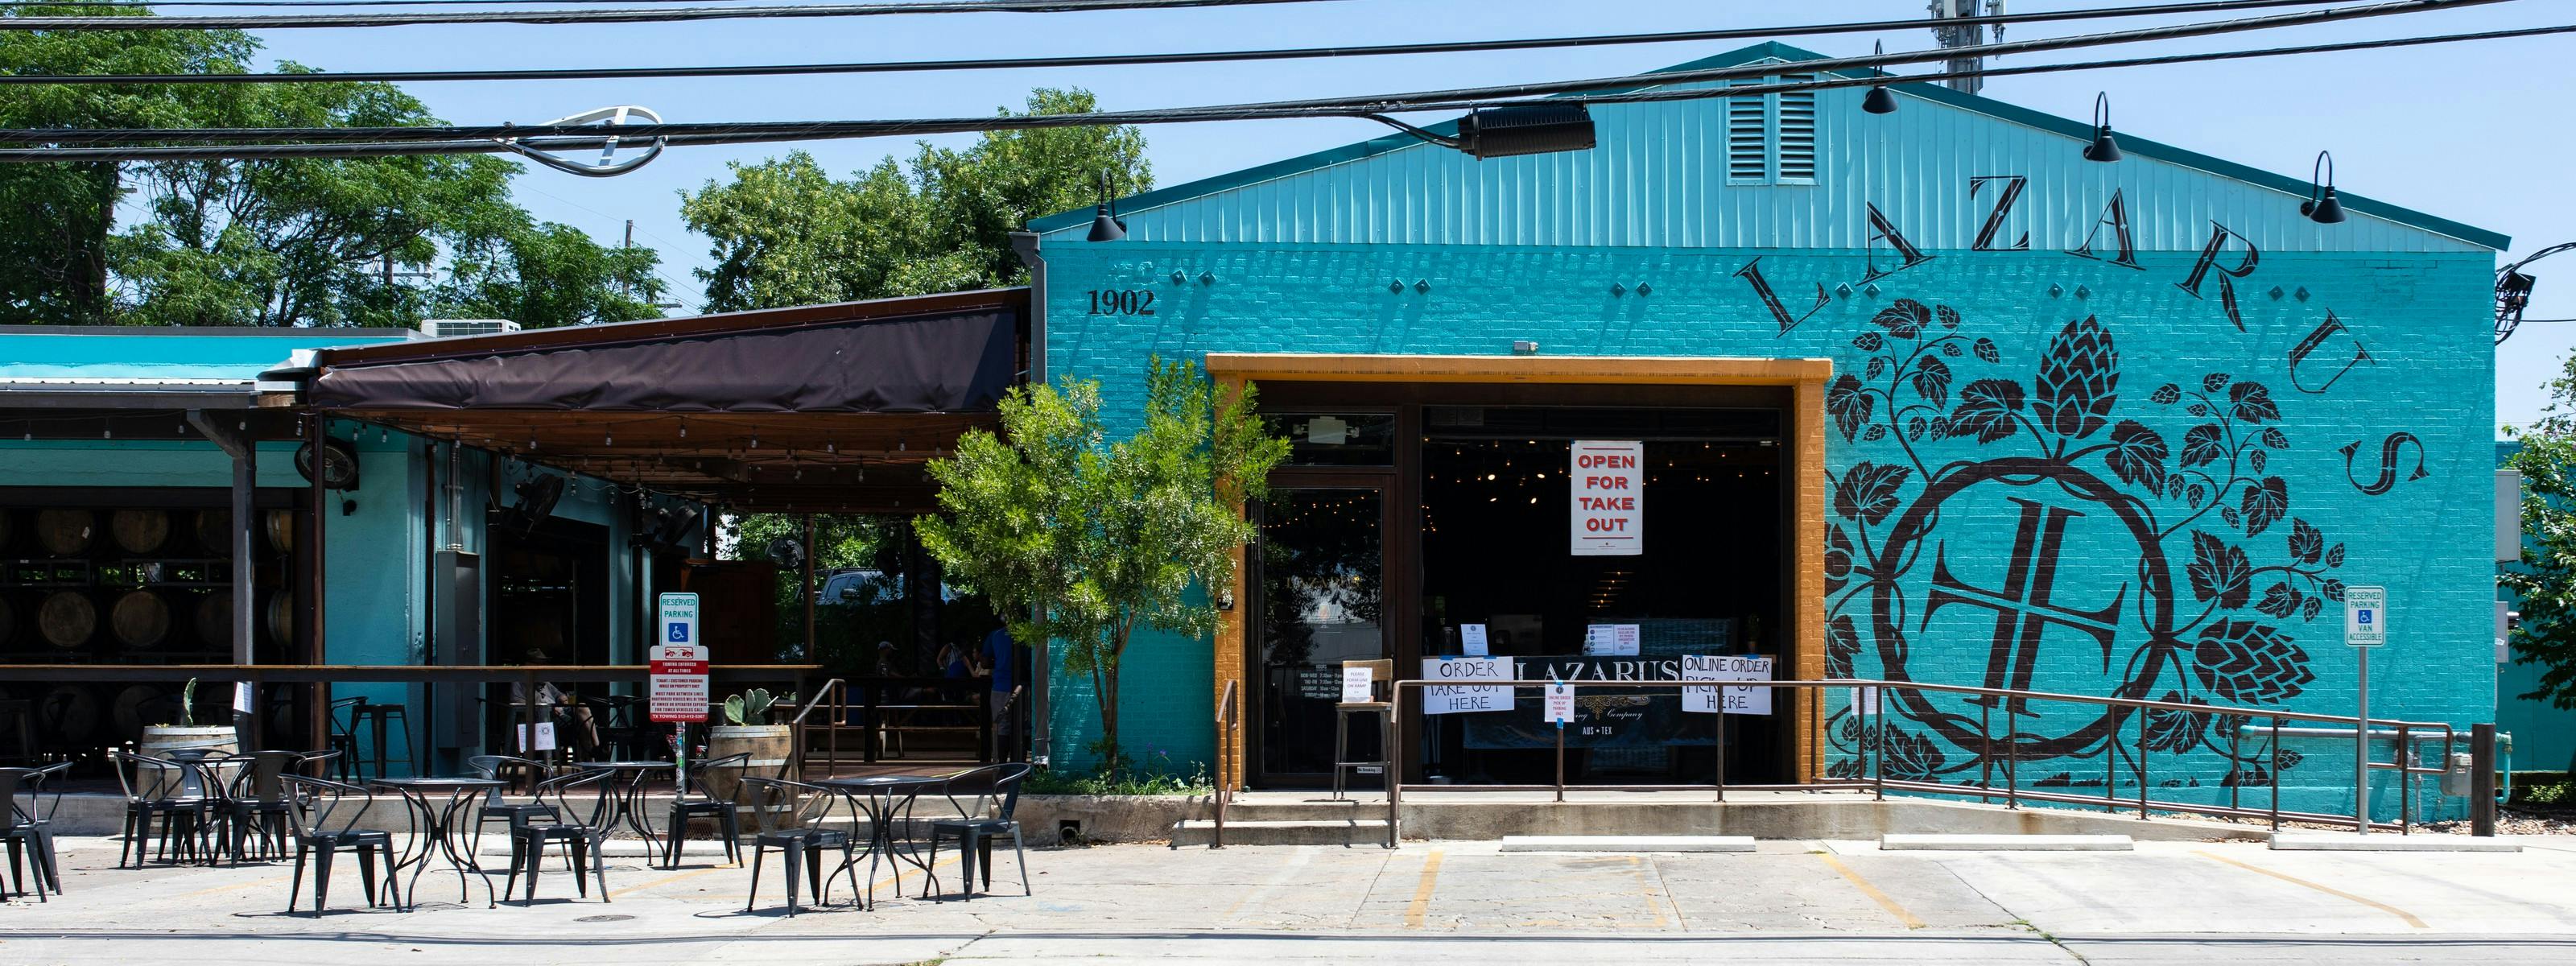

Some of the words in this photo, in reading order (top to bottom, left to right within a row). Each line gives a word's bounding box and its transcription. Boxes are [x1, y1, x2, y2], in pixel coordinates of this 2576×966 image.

[1088, 290, 1154, 316] 1902
[1732, 176, 2429, 495] LAZARUS
[1578, 455, 1635, 469] OPEN
[1586, 476, 1628, 489] FOR
[1579, 497, 1635, 510] TAKE
[1586, 518, 1628, 531] OUT
[1440, 662, 1498, 677] ORDER
[1685, 657, 1727, 671] ONLINE
[1732, 659, 1769, 673] ORDER
[1515, 660, 1680, 687] LAZARUS
[1430, 683, 1465, 696] TAKE
[1686, 676, 1718, 693] PICK
[1737, 677, 1757, 692] UP
[1449, 696, 1491, 710] HERE
[1607, 708, 1642, 720] Company
[1583, 726, 1594, 734] AUS
[1601, 726, 1612, 734] TEX
